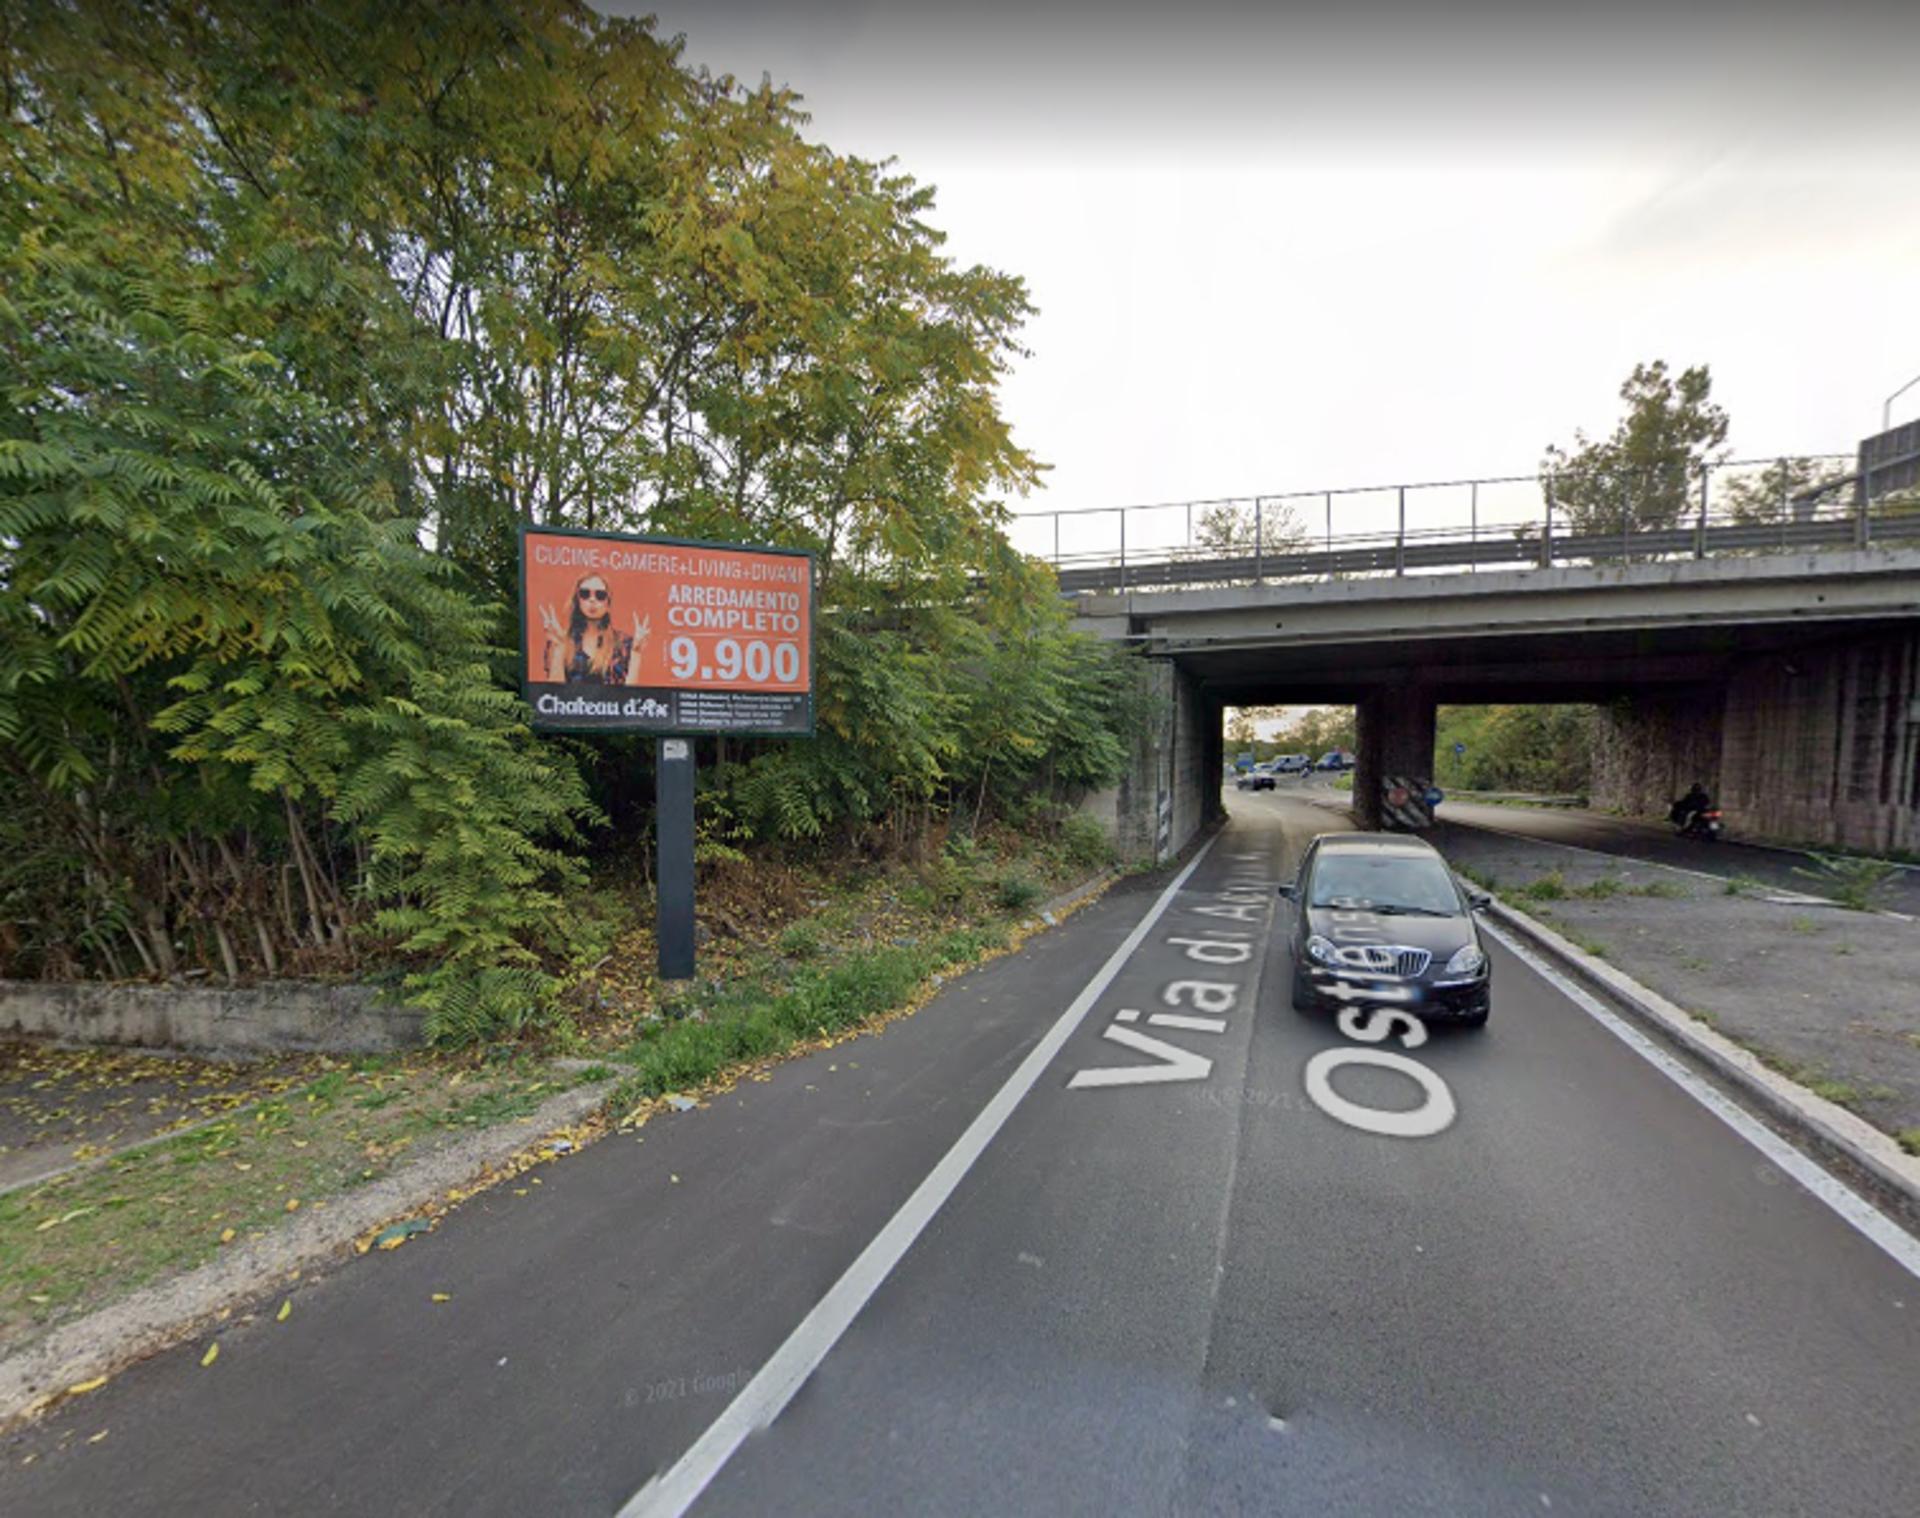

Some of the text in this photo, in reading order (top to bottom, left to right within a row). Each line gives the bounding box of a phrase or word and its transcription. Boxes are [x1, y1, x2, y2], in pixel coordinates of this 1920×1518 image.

[668, 584, 800, 611] ARREDAMENTO
[668, 606, 800, 633] COMPLETO
[670, 636, 800, 682] 9.900
[537, 693, 620, 716] Chateau
